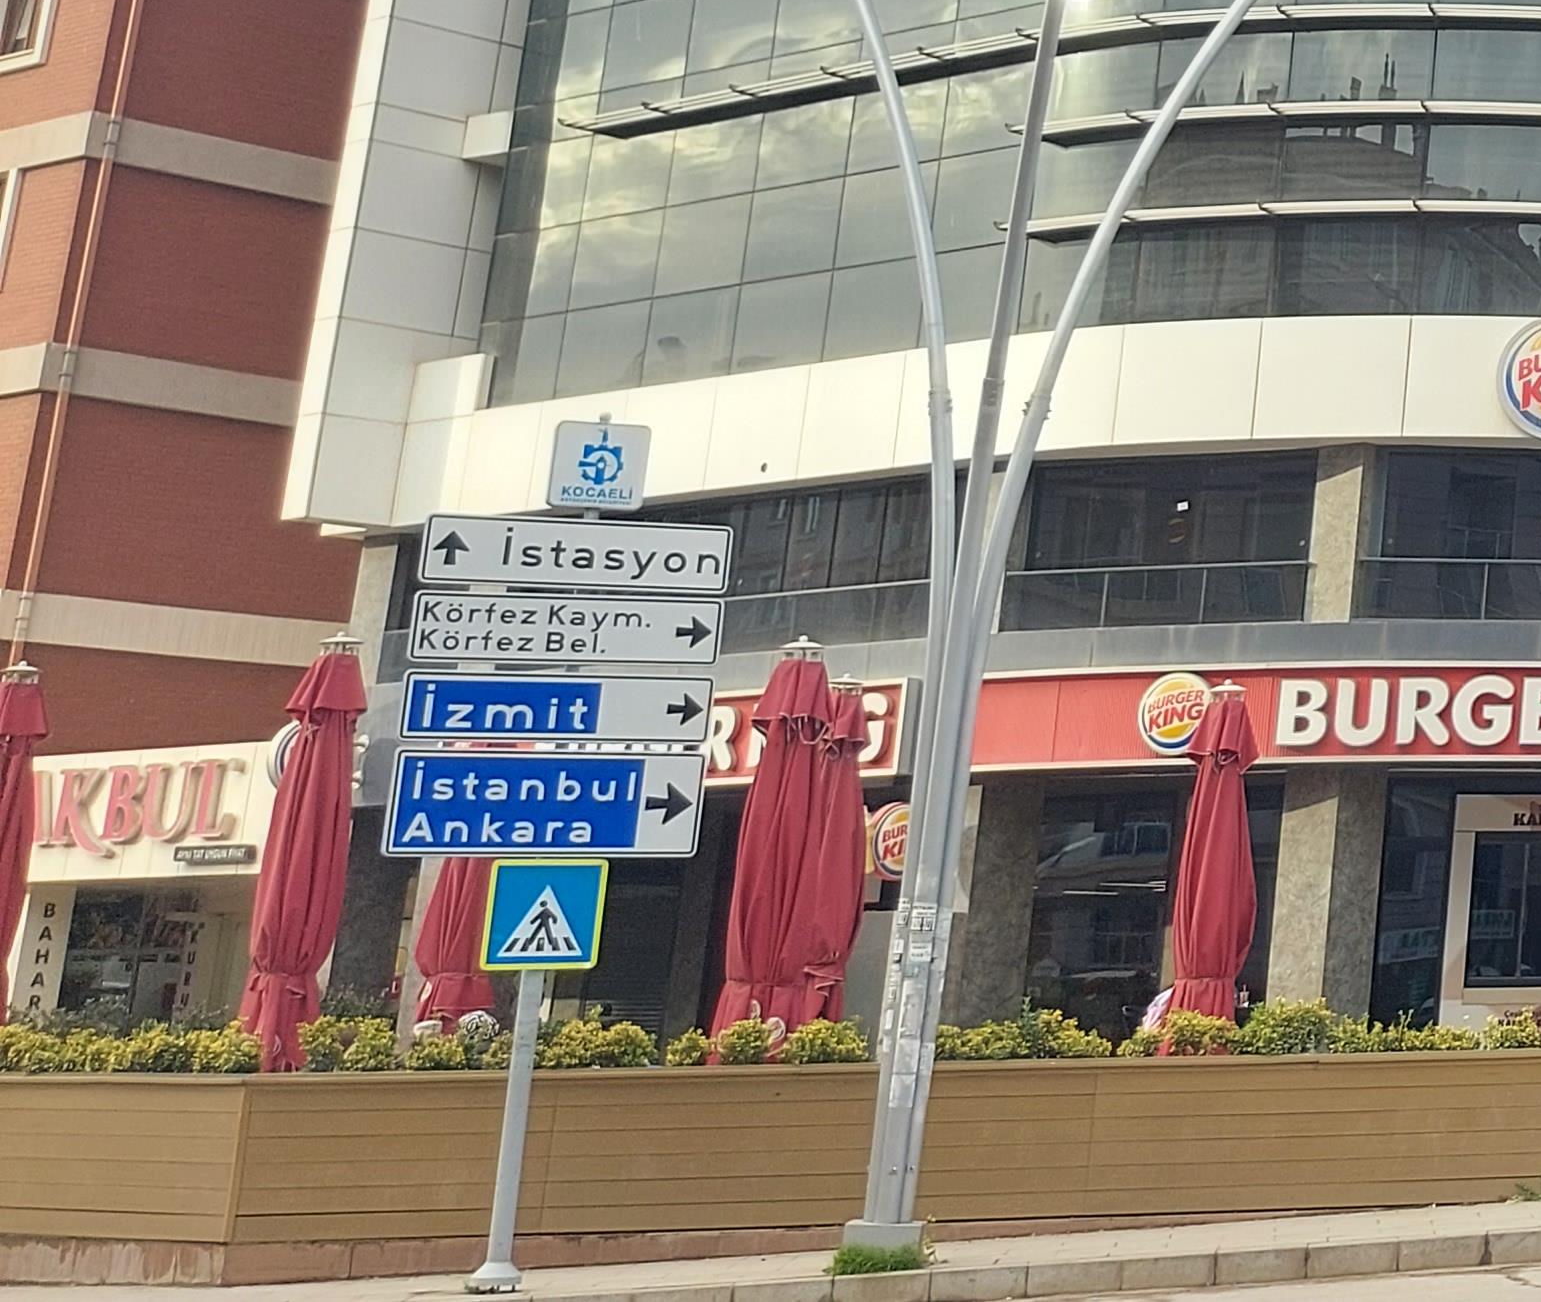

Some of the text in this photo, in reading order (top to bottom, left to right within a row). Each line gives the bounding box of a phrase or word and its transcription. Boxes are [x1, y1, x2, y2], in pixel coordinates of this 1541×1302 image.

[501, 527, 722, 580] İstasyon
[421, 601, 652, 632] Körfez Kaym.
[418, 629, 607, 655] Körfez Bel.
[422, 683, 589, 731] İzmit
[1147, 689, 1205, 715] BURGER
[1148, 702, 1205, 734] KING
[411, 760, 638, 802] İstanbul
[401, 812, 593, 844] Ankara
